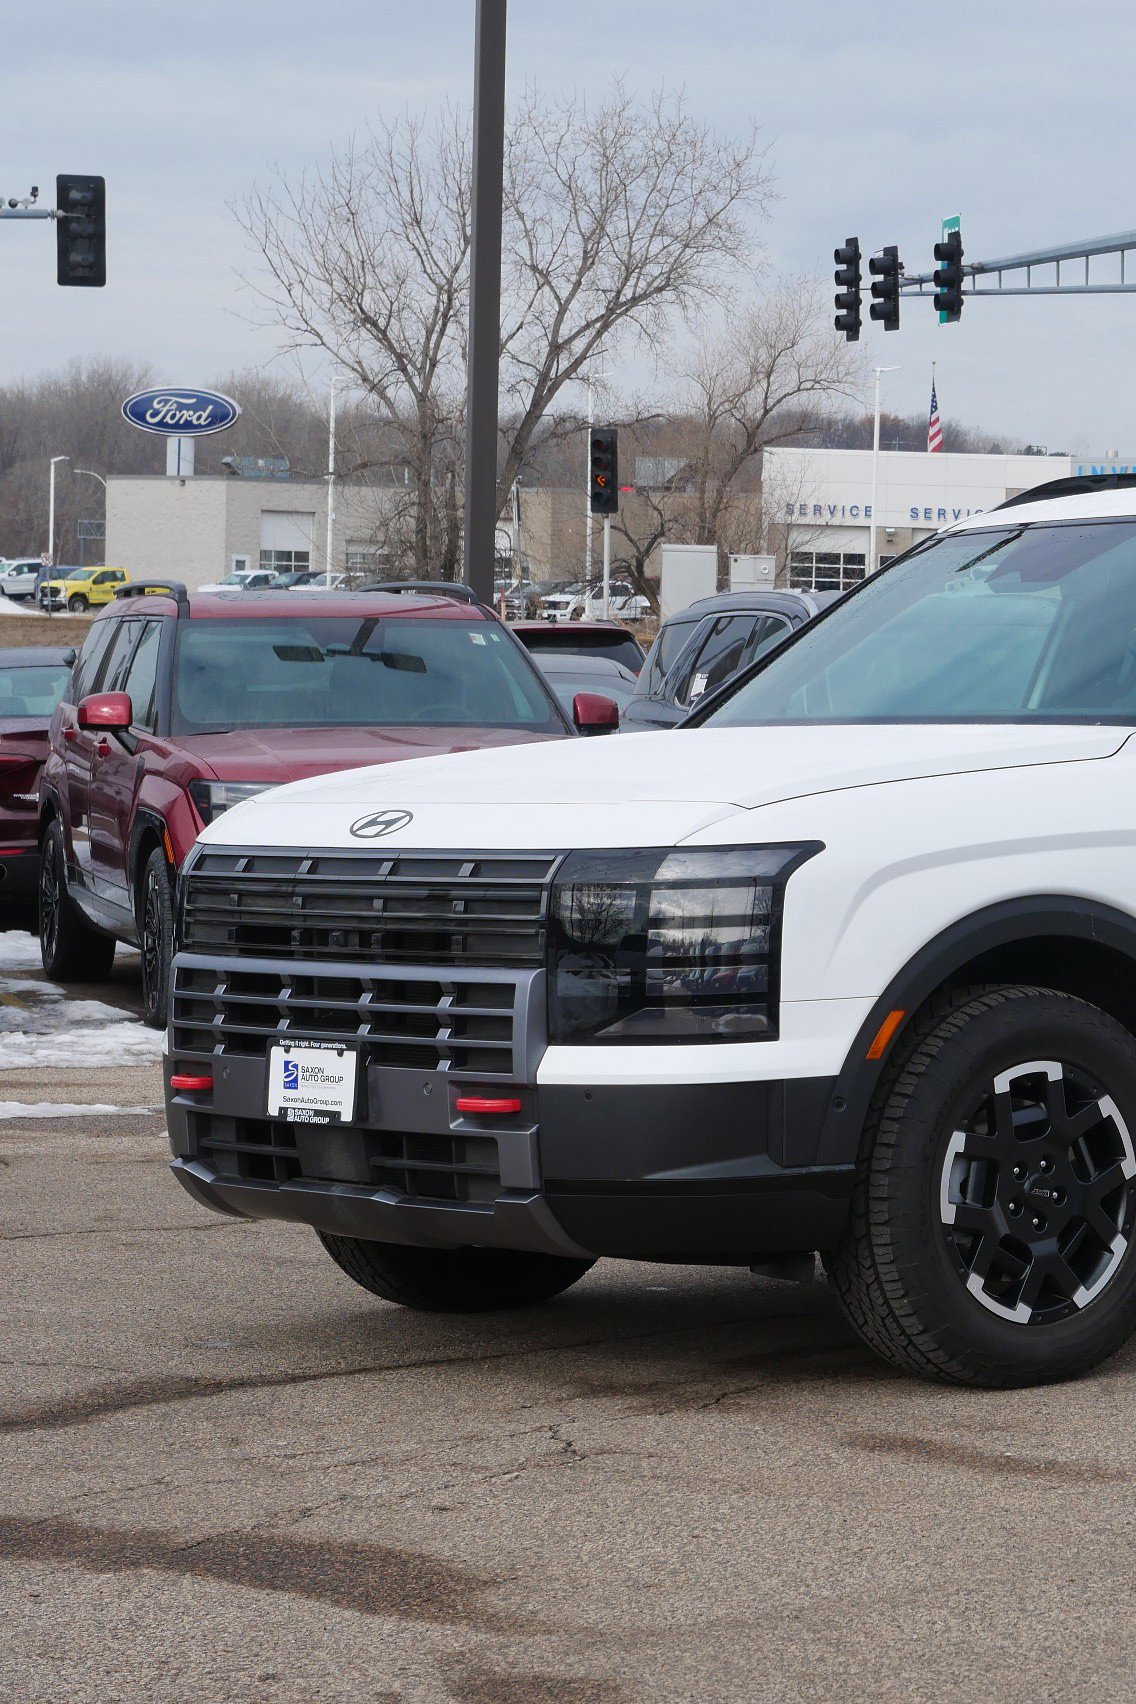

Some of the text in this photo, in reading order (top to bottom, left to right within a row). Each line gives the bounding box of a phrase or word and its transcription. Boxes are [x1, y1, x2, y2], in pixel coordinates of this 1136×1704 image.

[145, 396, 214, 426] Ford
[786, 502, 872, 517] SERVICE
[301, 1066, 325, 1075] SAXON
[301, 1074, 344, 1084] AUTO GROUP
[282, 1095, 343, 1107] SaxonAutoGroup.com
[293, 1115, 330, 1125] AUTO GROUP
